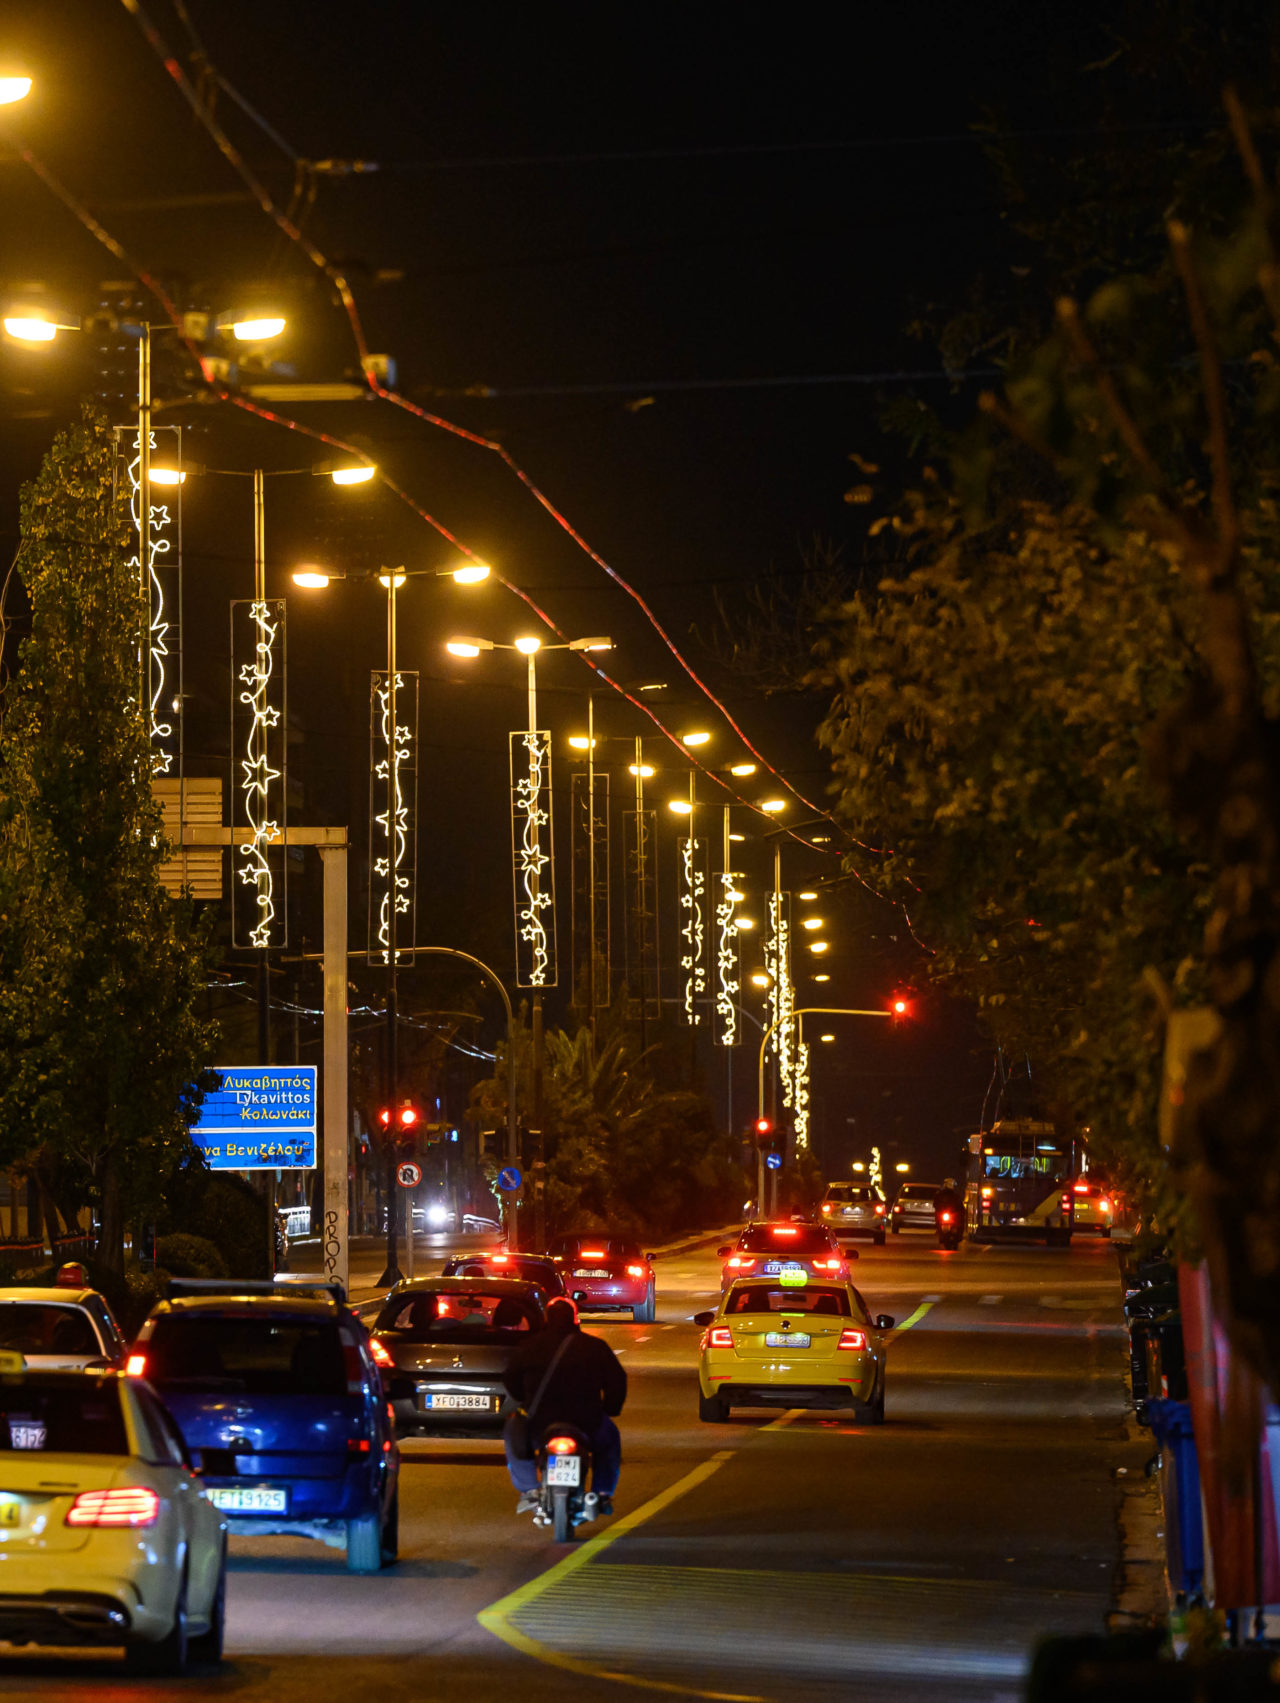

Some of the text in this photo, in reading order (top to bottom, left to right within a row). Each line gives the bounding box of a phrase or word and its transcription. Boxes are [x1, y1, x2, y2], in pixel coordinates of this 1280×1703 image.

[223, 1074, 311, 1091] Λυκαβηττός
[236, 1091, 311, 1106] Lykavittos
[241, 1106, 310, 1120] Κολωνάκι
[226, 1142, 303, 1159] Βενιζέλου
[460, 1396, 488, 1407] 3884
